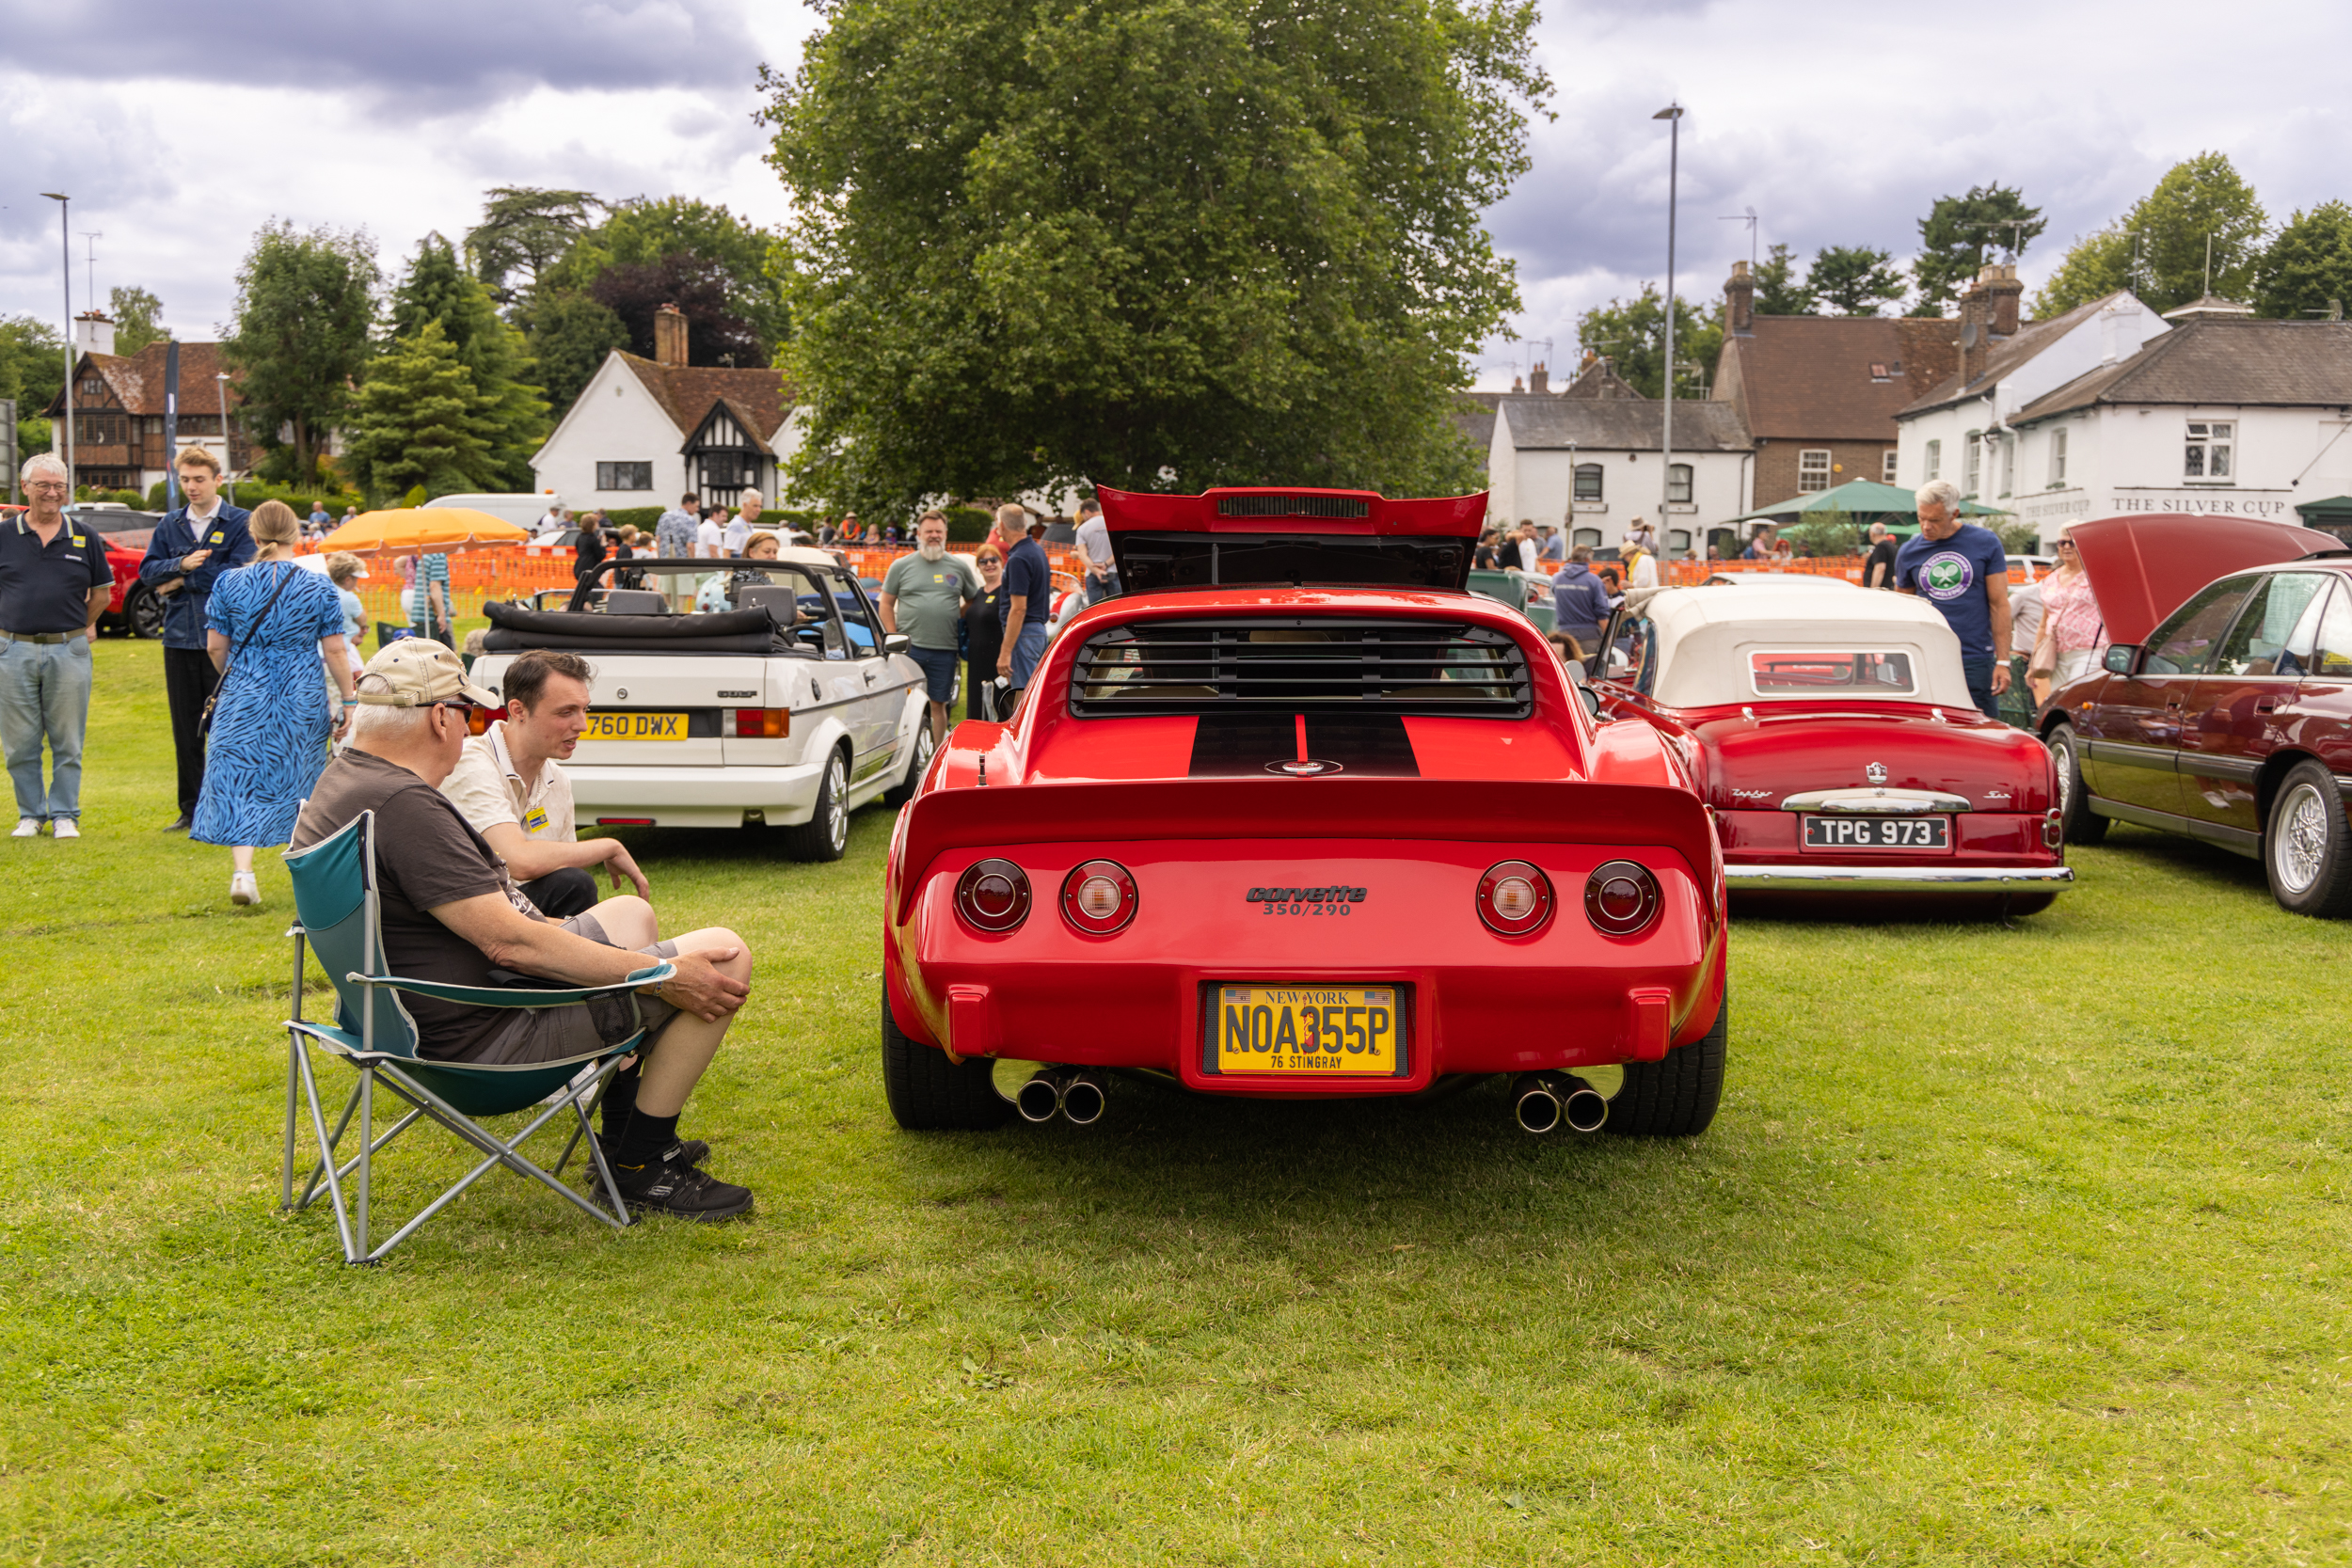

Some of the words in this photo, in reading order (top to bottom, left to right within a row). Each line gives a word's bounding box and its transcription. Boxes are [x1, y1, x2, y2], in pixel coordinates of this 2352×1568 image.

[2111, 499, 2154, 511] THE
[2164, 499, 2234, 513] SILVER
[2243, 500, 2285, 516] CUP
[717, 690, 757, 699] GOLF
[588, 716, 628, 736] 760
[635, 716, 678, 736] DWX
[1820, 820, 1870, 844] TPG
[1882, 820, 1931, 845] 973
[1246, 885, 1368, 902] corvette
[1263, 903, 1351, 917] 350/290
[1265, 990, 1301, 1004] NEW
[1306, 991, 1349, 1005] YORK
[1226, 1005, 1390, 1054] NOA355P
[1271, 1055, 1283, 1069] 76
[1289, 1056, 1343, 1069] STINGRAY
